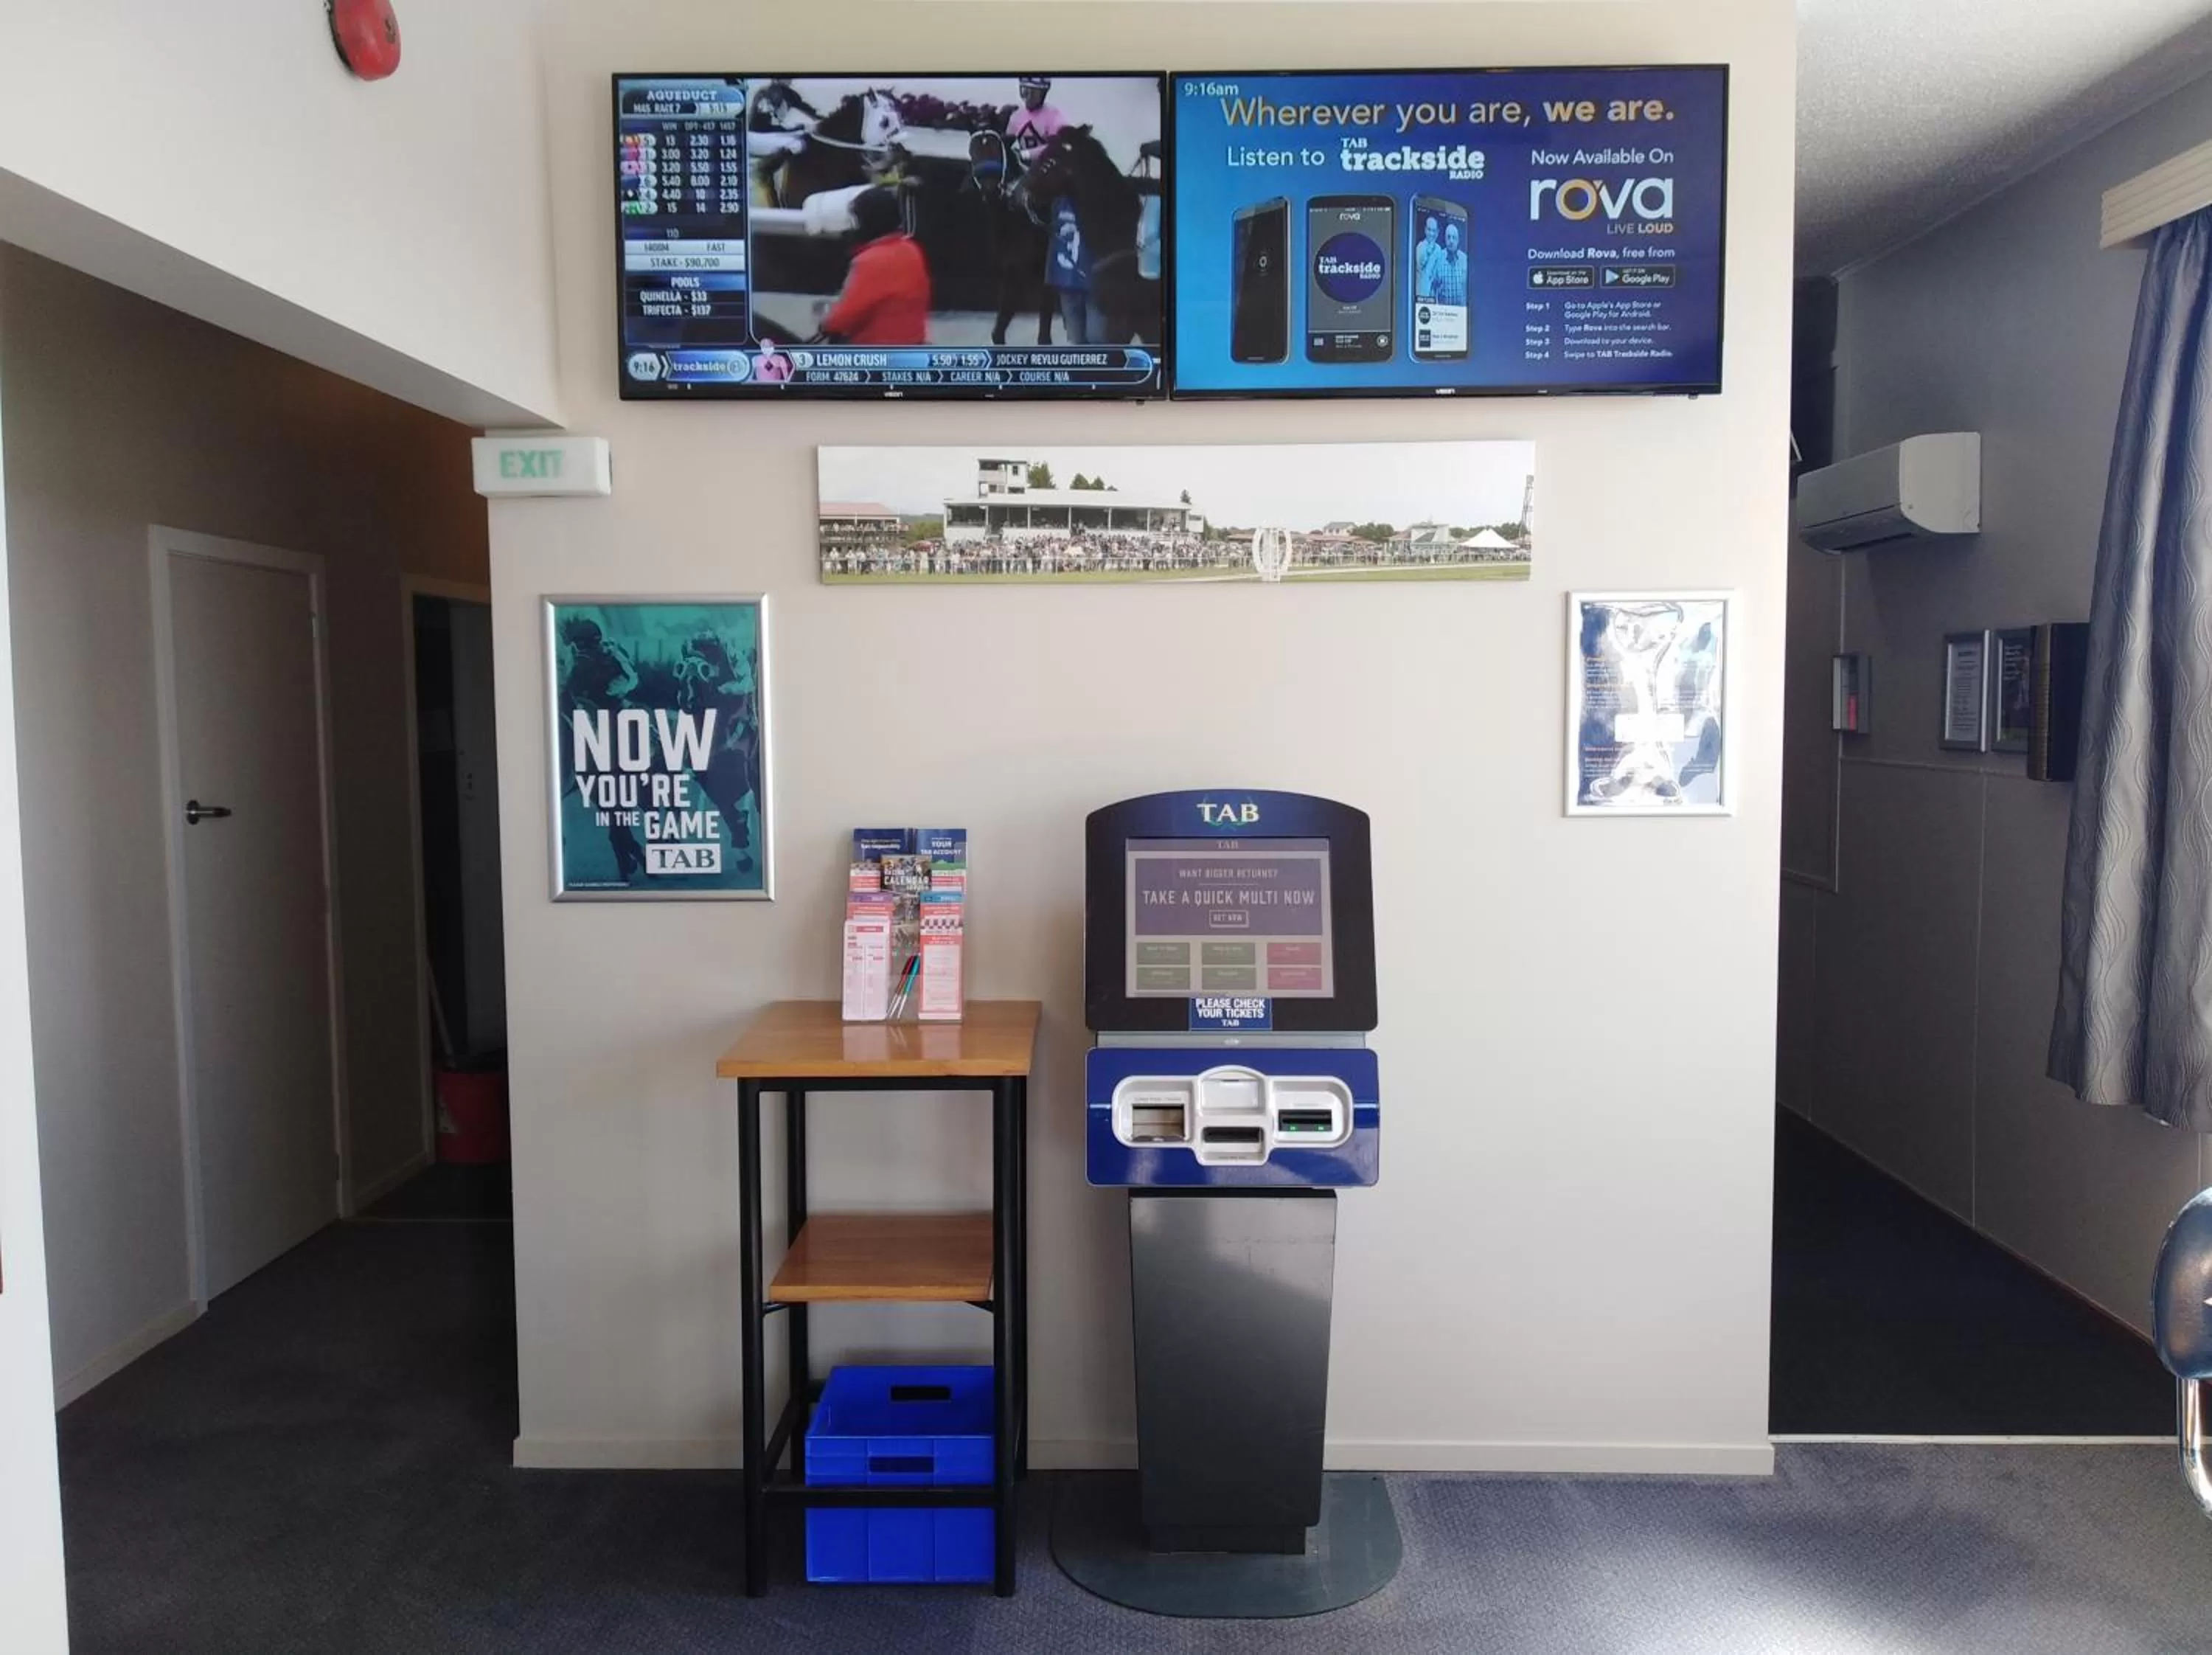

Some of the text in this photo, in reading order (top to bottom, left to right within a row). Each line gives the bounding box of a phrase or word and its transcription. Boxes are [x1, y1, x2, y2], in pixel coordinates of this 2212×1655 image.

[1185, 83, 1239, 95] 9:16am
[647, 90, 717, 101] AQUEDUCT
[1220, 96, 1674, 133] Wherever you are, we are.
[1340, 138, 1367, 148] TAB
[1228, 145, 1484, 172] Listen to trackside
[1531, 148, 1674, 165] Now Available On
[1450, 170, 1484, 180] RADIO
[1530, 178, 1674, 221] rova
[1340, 212, 1360, 221] rova
[1607, 223, 1674, 235] LIVE LOUD
[706, 243, 726, 251] FAST
[1528, 246, 1675, 260] Download Rova, free from
[650, 258, 678, 268] STAKE
[1318, 262, 1381, 274] trackside
[671, 277, 700, 288] POOLS
[1547, 275, 1589, 285] App Store
[1623, 274, 1670, 286] Google Play
[640, 291, 682, 303] QUINELLA
[642, 305, 682, 316] TRIFECTA
[799, 353, 887, 367] 3 LEMON CRUSH
[932, 354, 952, 366] 5.50
[996, 353, 1107, 366] JOCKEY REYLU GUTIERREZ
[634, 361, 655, 372] 9:16
[673, 361, 727, 373] trackside
[806, 370, 830, 382] FORM
[882, 371, 931, 382] STAKES N/A
[950, 371, 1001, 381] CAREER N/A
[1020, 371, 1069, 381] COURSE N/A
[500, 449, 563, 478] EXIT
[572, 709, 717, 772] NOW
[575, 773, 691, 808] YOU'RE
[1197, 803, 1260, 822] TAB
[596, 811, 720, 839] IN THE GAME
[931, 840, 952, 848] YOUR
[651, 849, 715, 868] TAB
[1180, 869, 1202, 878] WANT
[1205, 869, 1234, 878] BIGGER
[1143, 890, 1315, 907] TAKE A QUICK MULTI NOW
[1195, 998, 1266, 1009] PLEASE CHECK
[1197, 1008, 1265, 1019] YOUR TICKETS
[1222, 1019, 1240, 1027] TAB
